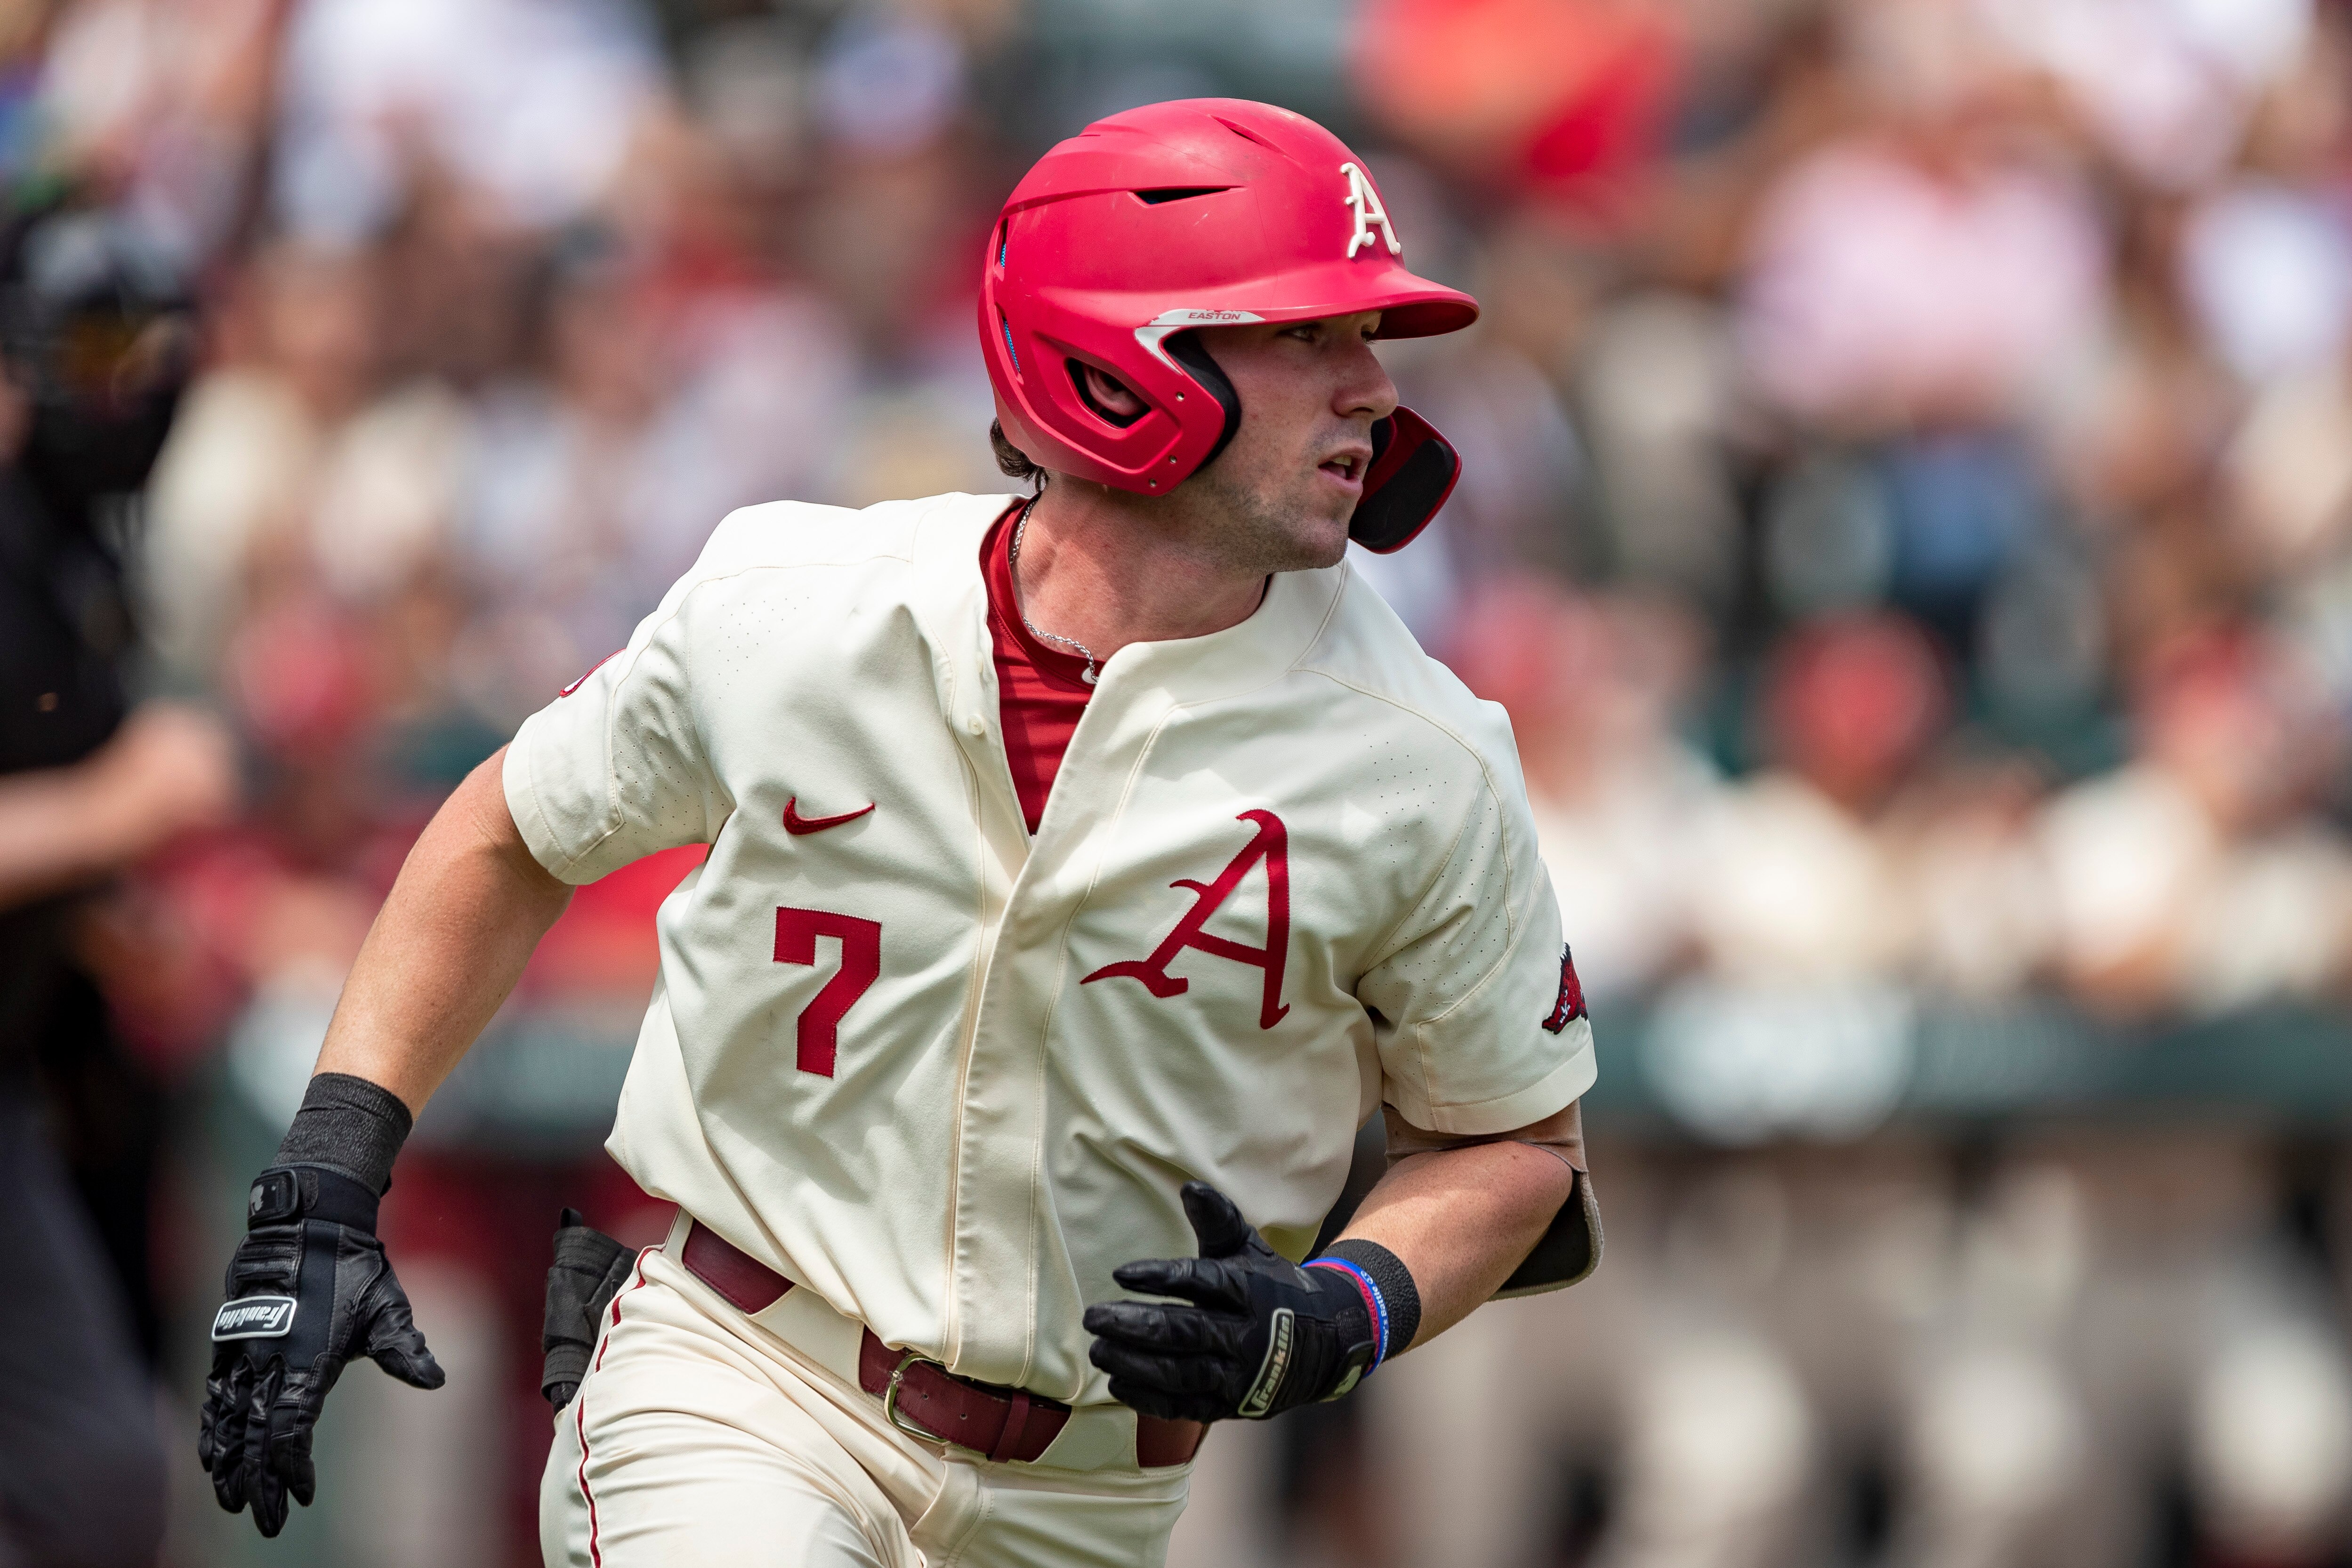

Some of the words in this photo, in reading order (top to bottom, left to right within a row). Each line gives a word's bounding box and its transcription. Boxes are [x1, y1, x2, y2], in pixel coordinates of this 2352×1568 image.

[1340, 162, 1402, 258] A
[1188, 312, 1241, 320] EASTON
[1079, 808, 1290, 1029] A
[773, 906, 882, 1078] 7
[1372, 1286, 1387, 1317] Battle
